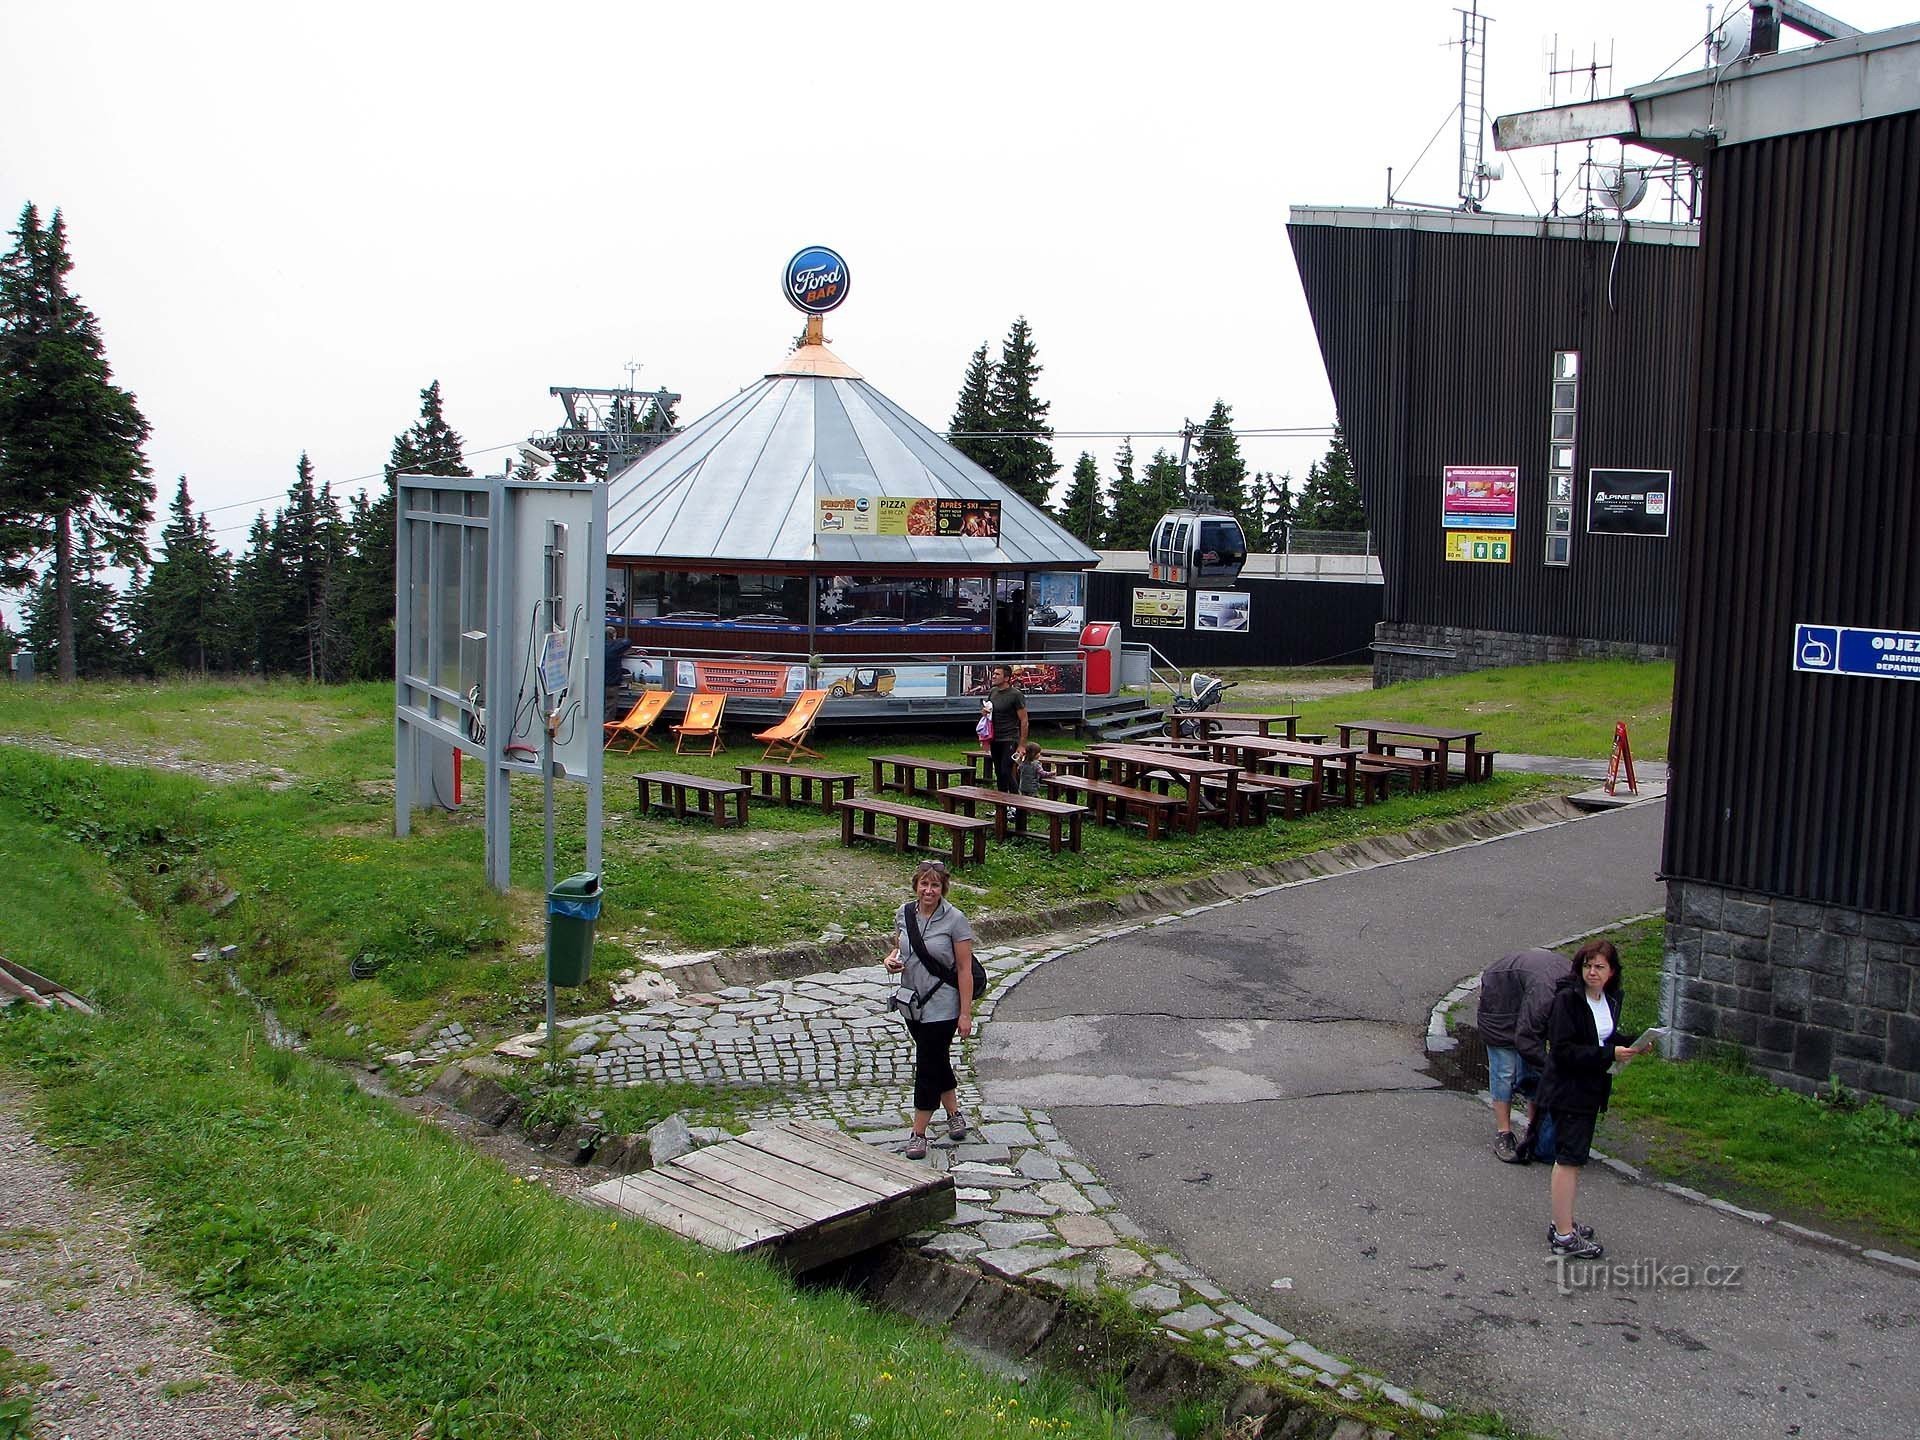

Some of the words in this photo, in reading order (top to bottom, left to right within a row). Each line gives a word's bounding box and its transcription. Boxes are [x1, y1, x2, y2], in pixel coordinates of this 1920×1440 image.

[794, 264, 842, 294] Ford
[806, 284, 837, 303] BAR
[1595, 491, 1630, 501] ALPINE
[880, 500, 906, 508] PIZZA
[939, 501, 962, 509] APRÈS
[1876, 663, 1920, 672] DEPARTU
